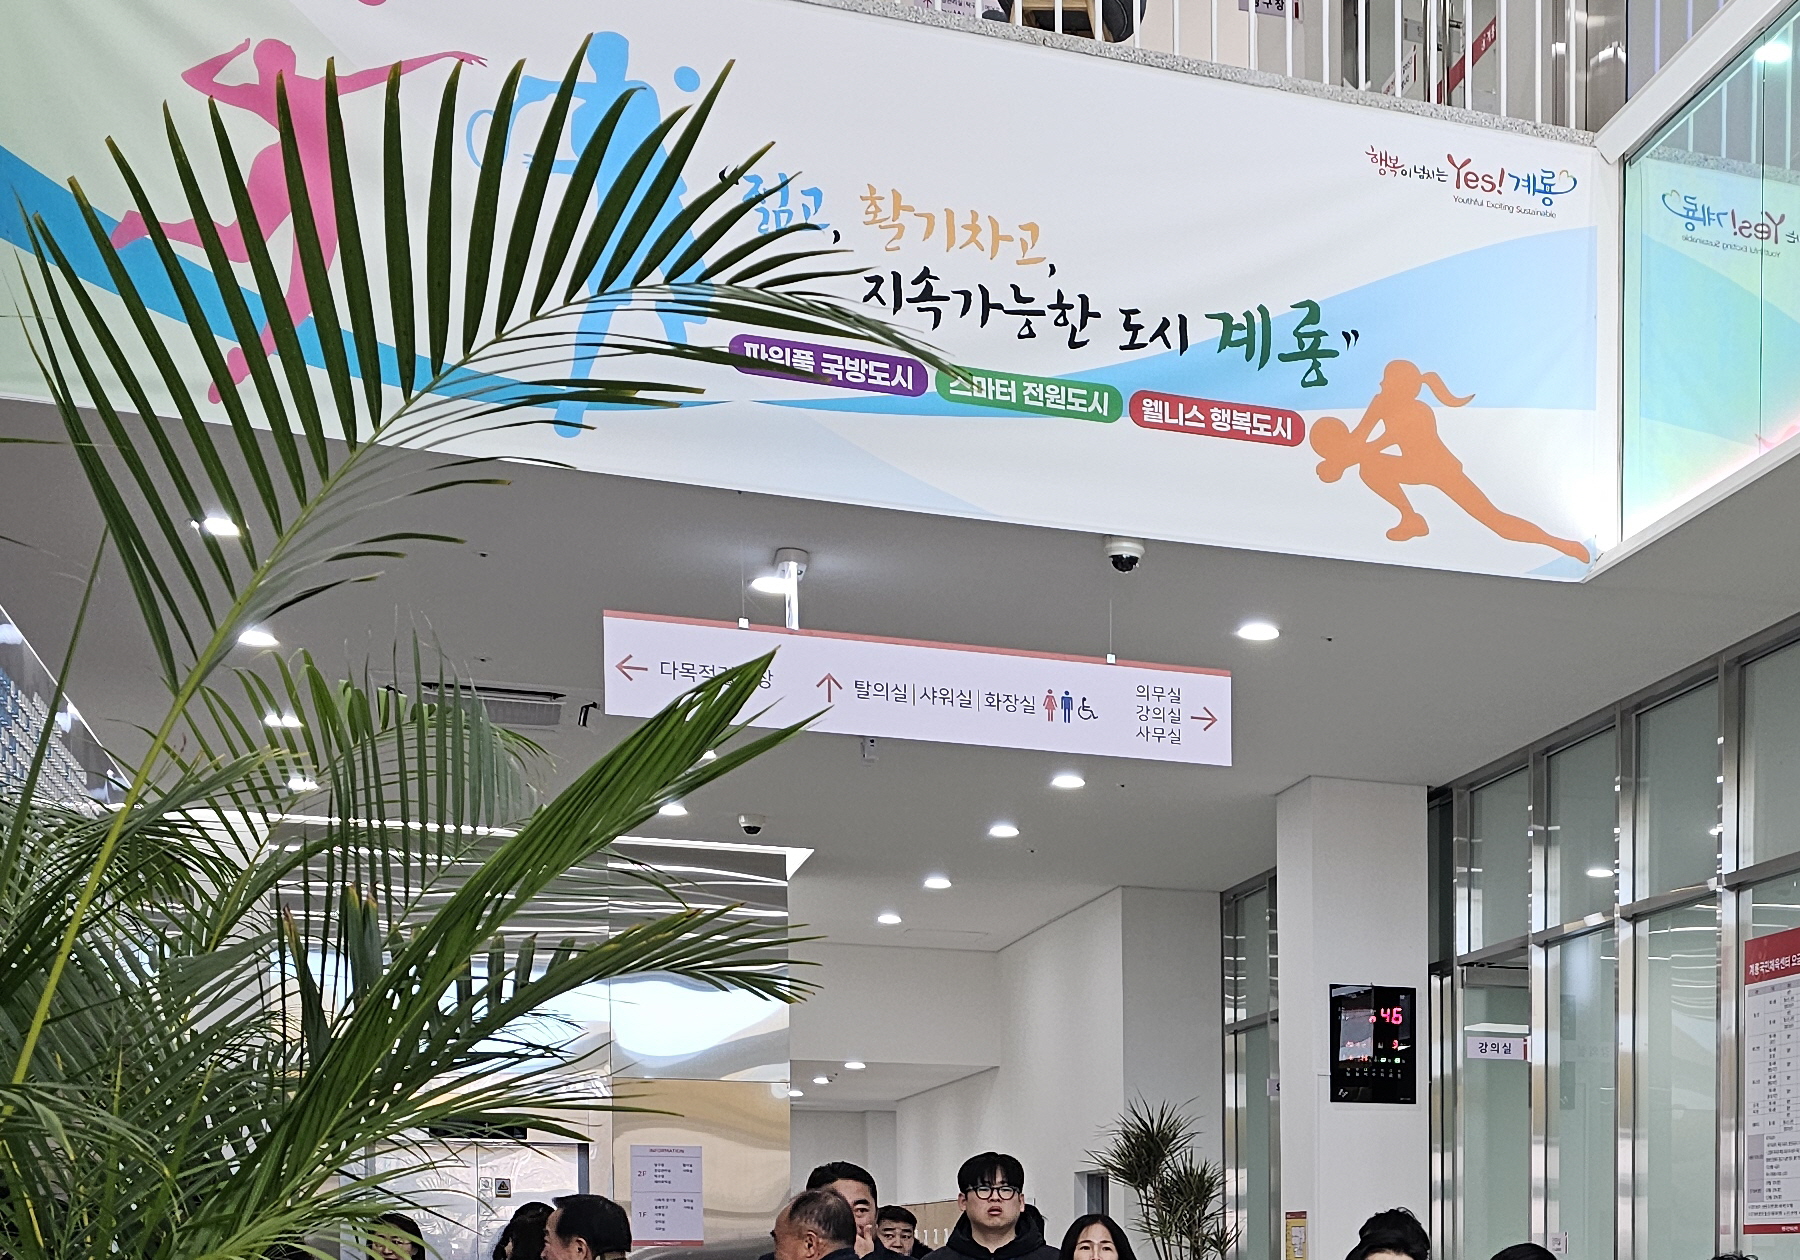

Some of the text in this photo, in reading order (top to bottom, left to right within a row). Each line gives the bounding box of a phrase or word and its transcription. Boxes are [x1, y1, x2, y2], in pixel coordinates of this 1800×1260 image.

[1447, 153, 1505, 194] Yes!
[1508, 169, 1577, 206] 계룡
[1453, 195, 1557, 218] Youthful Exciting Sustainable
[859, 183, 1057, 278] 활기차고,
[860, 263, 1102, 349] 지속가능한
[1119, 305, 1188, 355] 도시
[821, 352, 914, 391] 국방도시
[1022, 384, 1110, 417] 전원도시
[1141, 398, 1293, 441] 웰니스 행복도시
[660, 660, 774, 689] 다목적장
[854, 679, 1036, 714] 탈의실 샤워실 화장실
[1135, 684, 1183, 704] 의무실
[1135, 704, 1183, 725] 강의실
[1135, 725, 1183, 746] 사무실
[1478, 1042, 1512, 1055] 강의실
